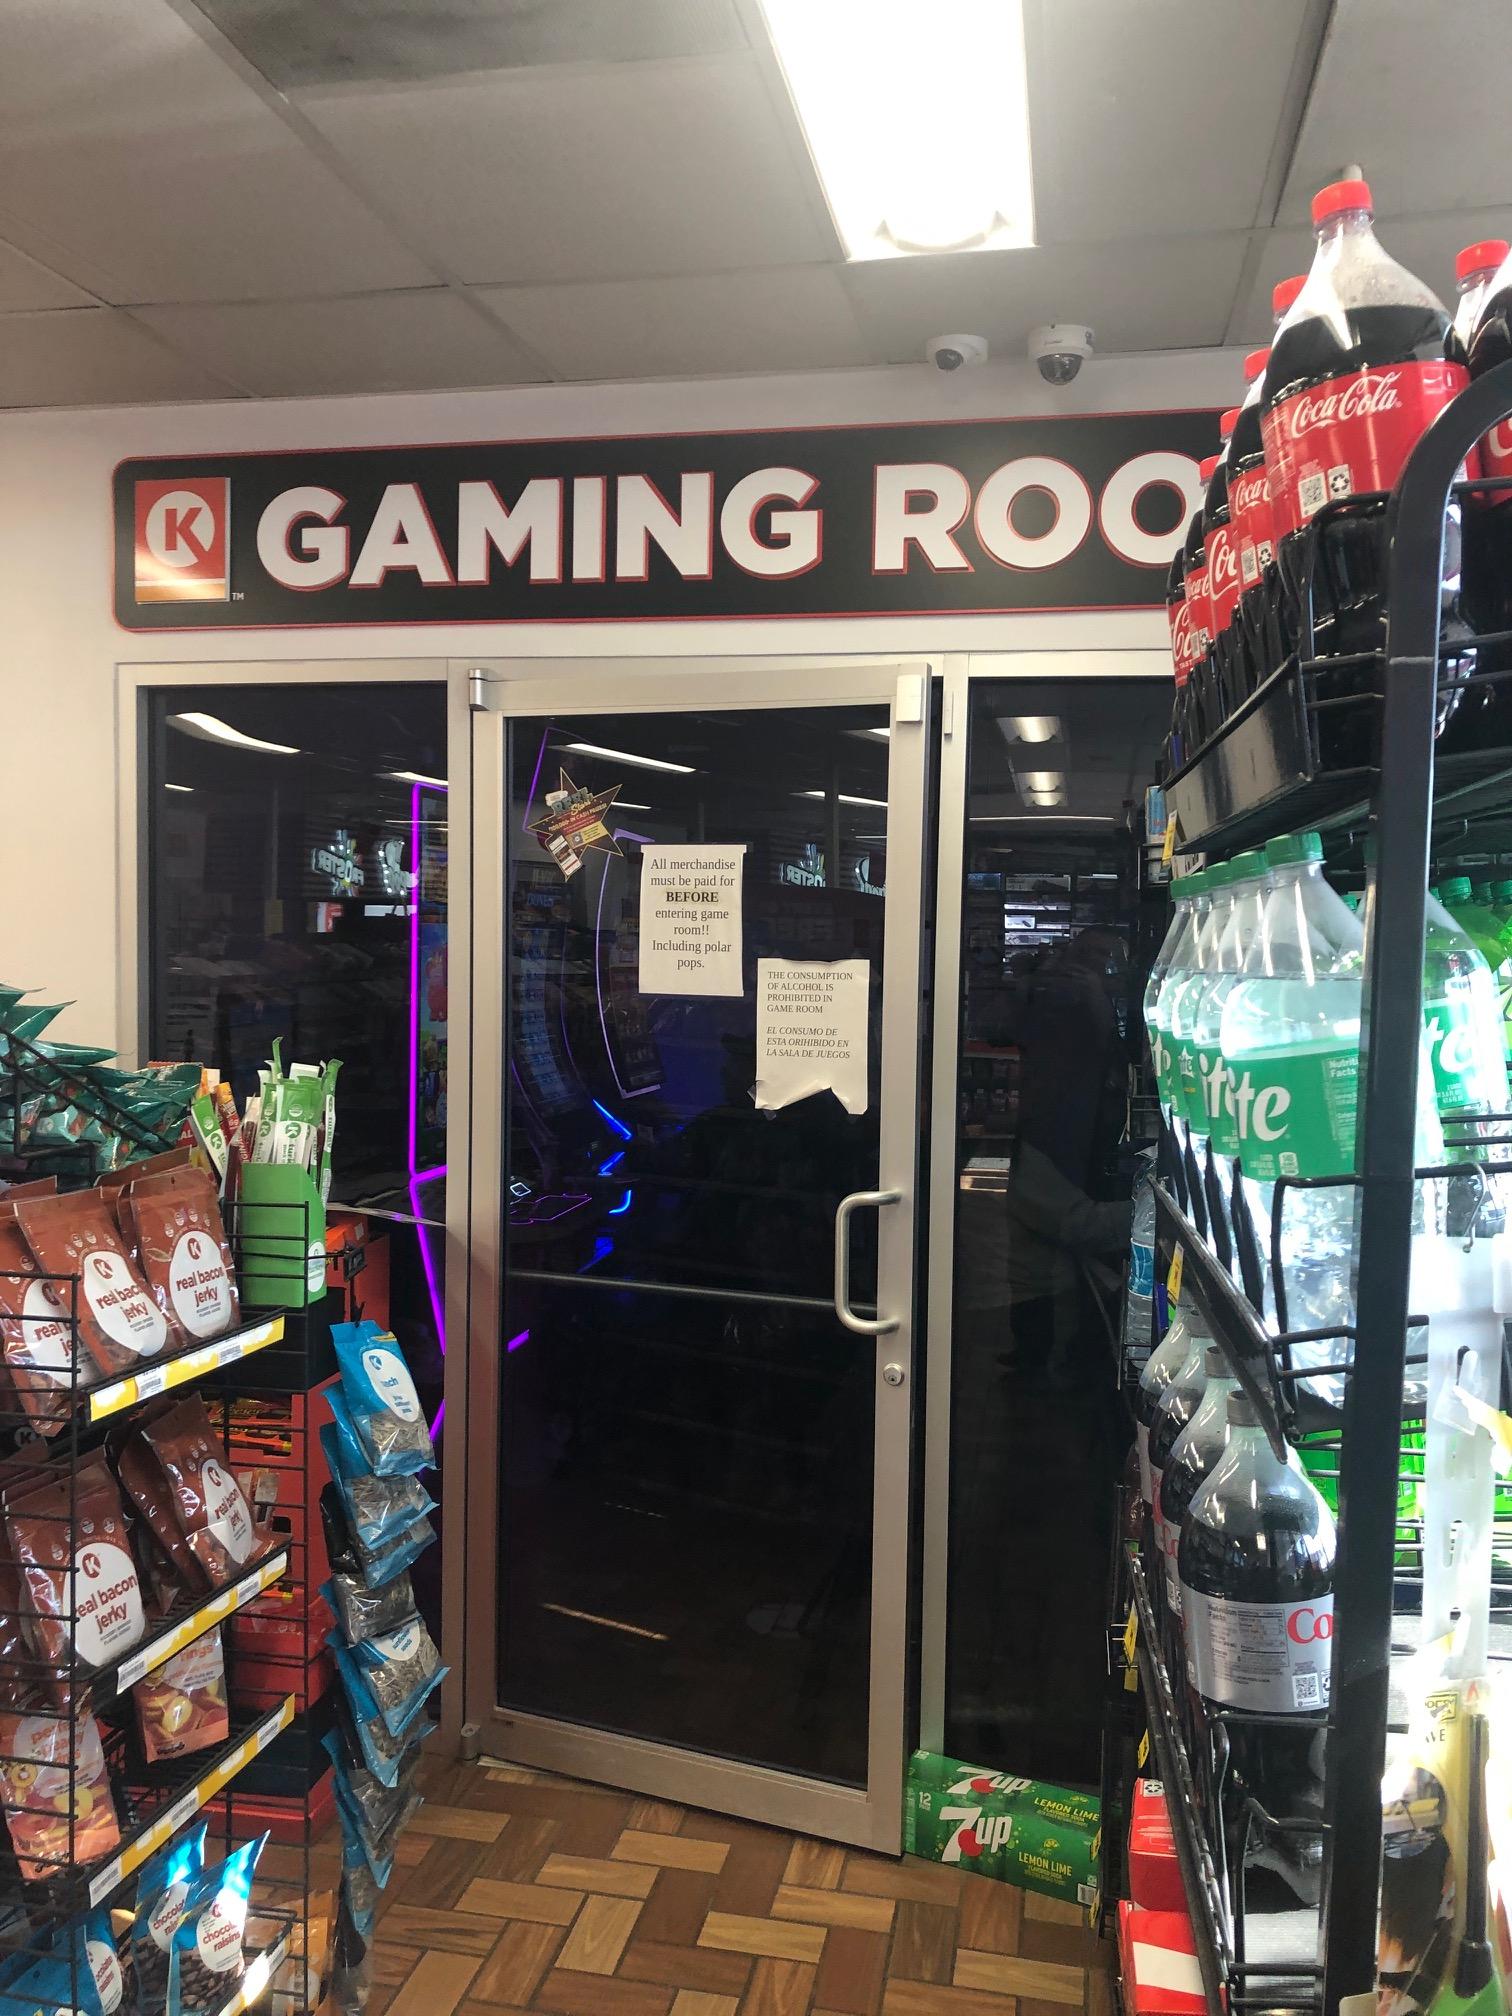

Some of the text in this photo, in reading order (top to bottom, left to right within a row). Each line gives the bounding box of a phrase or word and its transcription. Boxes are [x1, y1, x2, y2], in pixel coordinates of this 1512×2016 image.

[256, 466, 822, 592] GAMING
[872, 449, 1201, 574] ROO
[650, 858, 736, 870] All merchandise
[650, 875, 736, 888] must be paid for
[666, 891, 719, 903] BEFORE
[655, 909, 729, 921] entering game
[673, 924, 710, 936] room!!
[652, 940, 732, 954] Including polar
[677, 958, 705, 970] pops.
[768, 971, 853, 980] THE CONSUMPTION
[767, 982, 834, 992] OF ALCOHOL IS
[767, 993, 833, 1003] PROHIBITED IN
[766, 1004, 823, 1014] GAME ROOM
[766, 1026, 838, 1036] EL CONSUMO DE
[766, 1037, 787, 1046] ESTA
[837, 1039, 850, 1047] EN
[766, 1049, 851, 1059] LA SALA DE JUEGOS
[1328, 1057, 1359, 1068] Nutriti
[175, 1273, 198, 1291] real
[96, 1289, 119, 1310] real
[194, 1286, 218, 1307] jerky
[120, 1301, 149, 1323] jerky
[99, 1574, 138, 1605] bacon
[95, 1602, 128, 1634] jerky
[1033, 1796, 1072, 1814] LEMON
[1073, 1804, 1100, 1823] LIME
[1018, 1851, 1049, 1870] LEMON
[1051, 1861, 1073, 1877] LIME
